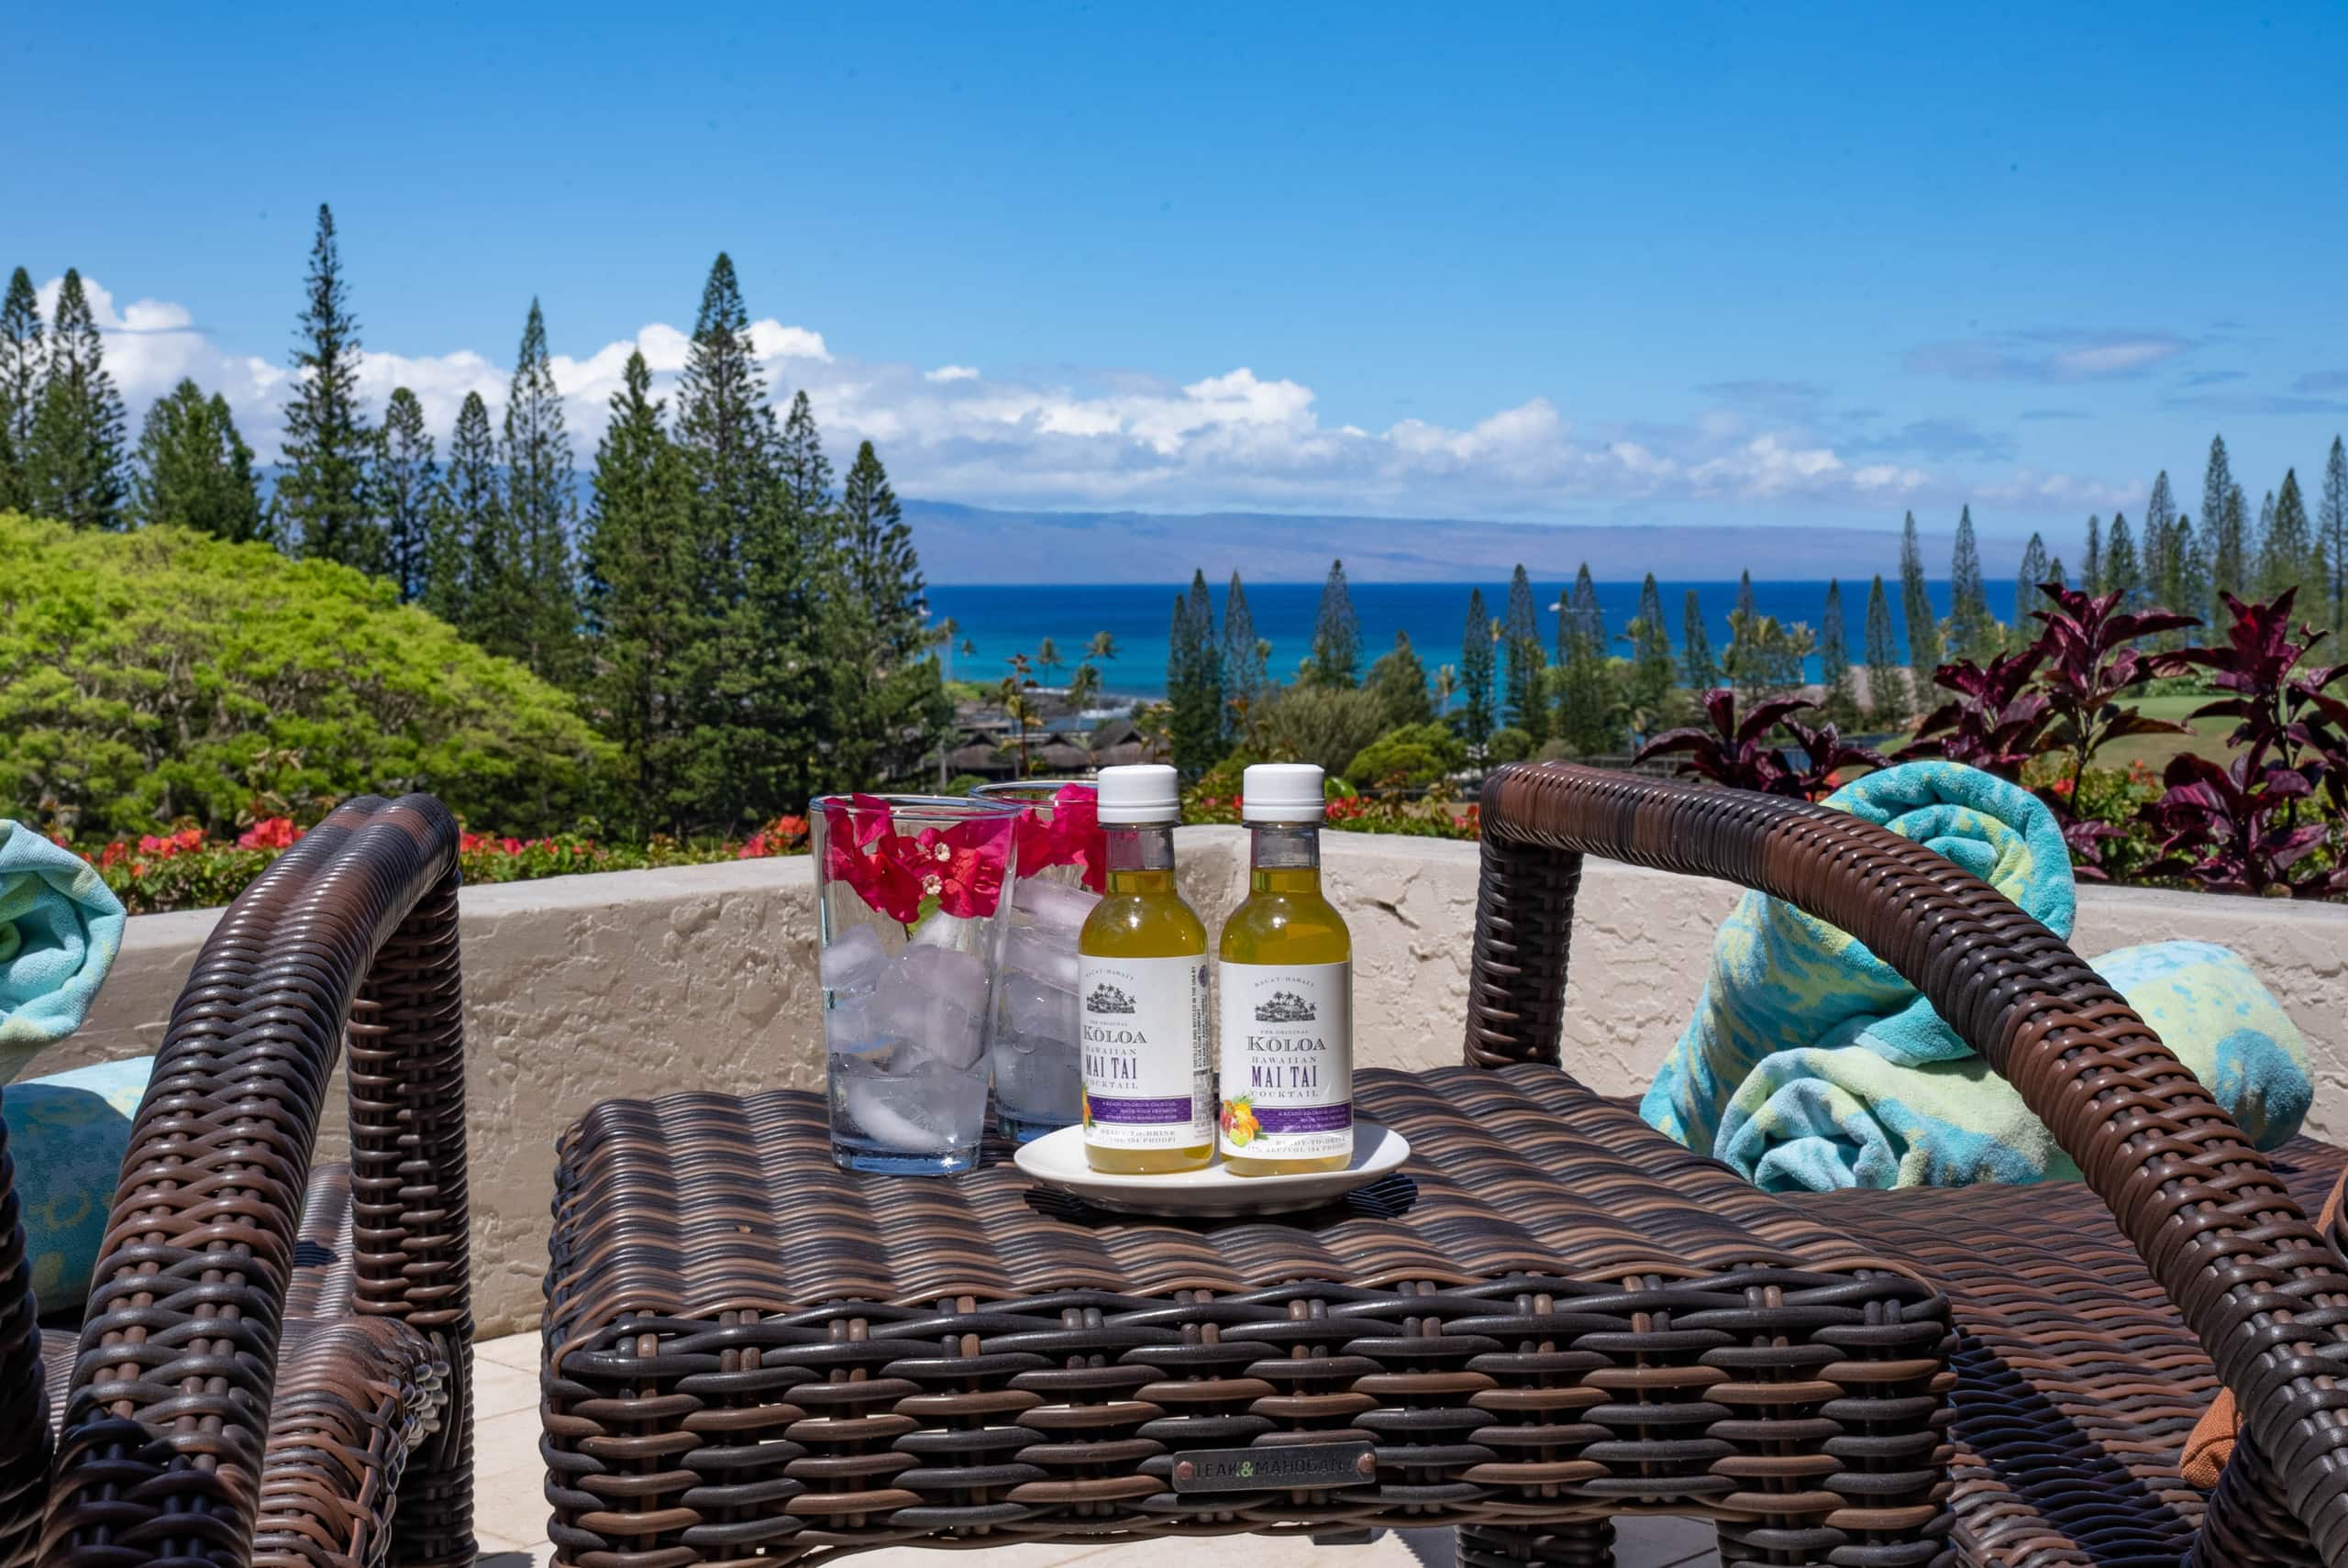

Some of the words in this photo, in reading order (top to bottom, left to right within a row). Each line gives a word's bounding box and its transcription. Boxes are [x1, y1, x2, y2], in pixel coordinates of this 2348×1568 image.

[1086, 1054, 1105, 1077] MAI
[1111, 1056, 1137, 1079] TAI
[1251, 1055, 1317, 1064] HAWAIIAN
[1251, 1065, 1281, 1088] MAI
[1290, 1065, 1317, 1088] TAI
[1250, 1088, 1318, 1099] COCKTAIL
